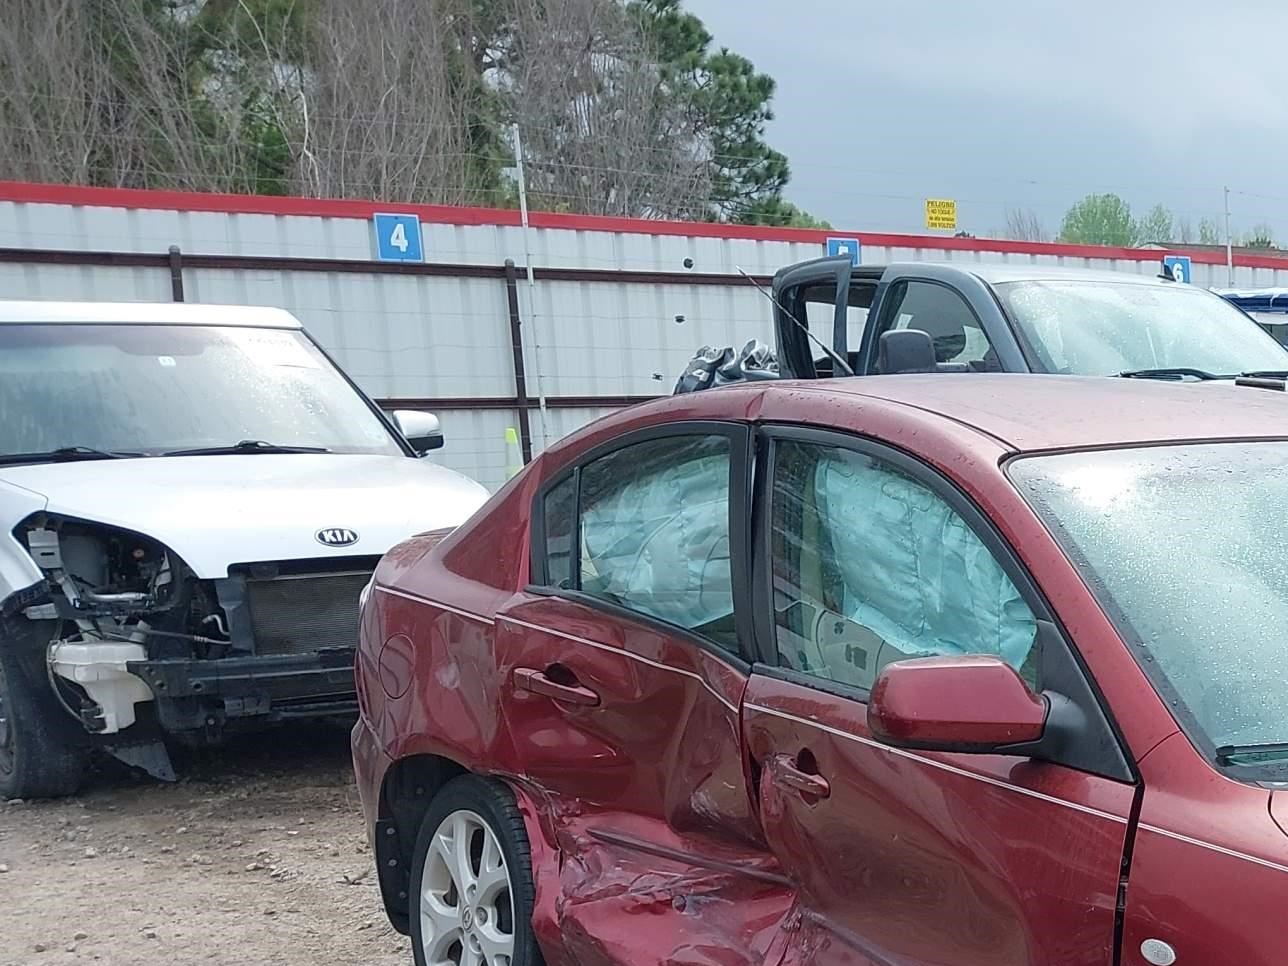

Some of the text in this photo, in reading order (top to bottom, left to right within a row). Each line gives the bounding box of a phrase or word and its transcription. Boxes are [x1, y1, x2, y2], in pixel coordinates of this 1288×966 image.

[390, 223, 409, 253] 4
[1172, 263, 1184, 283] 6
[322, 529, 355, 542] KIA
